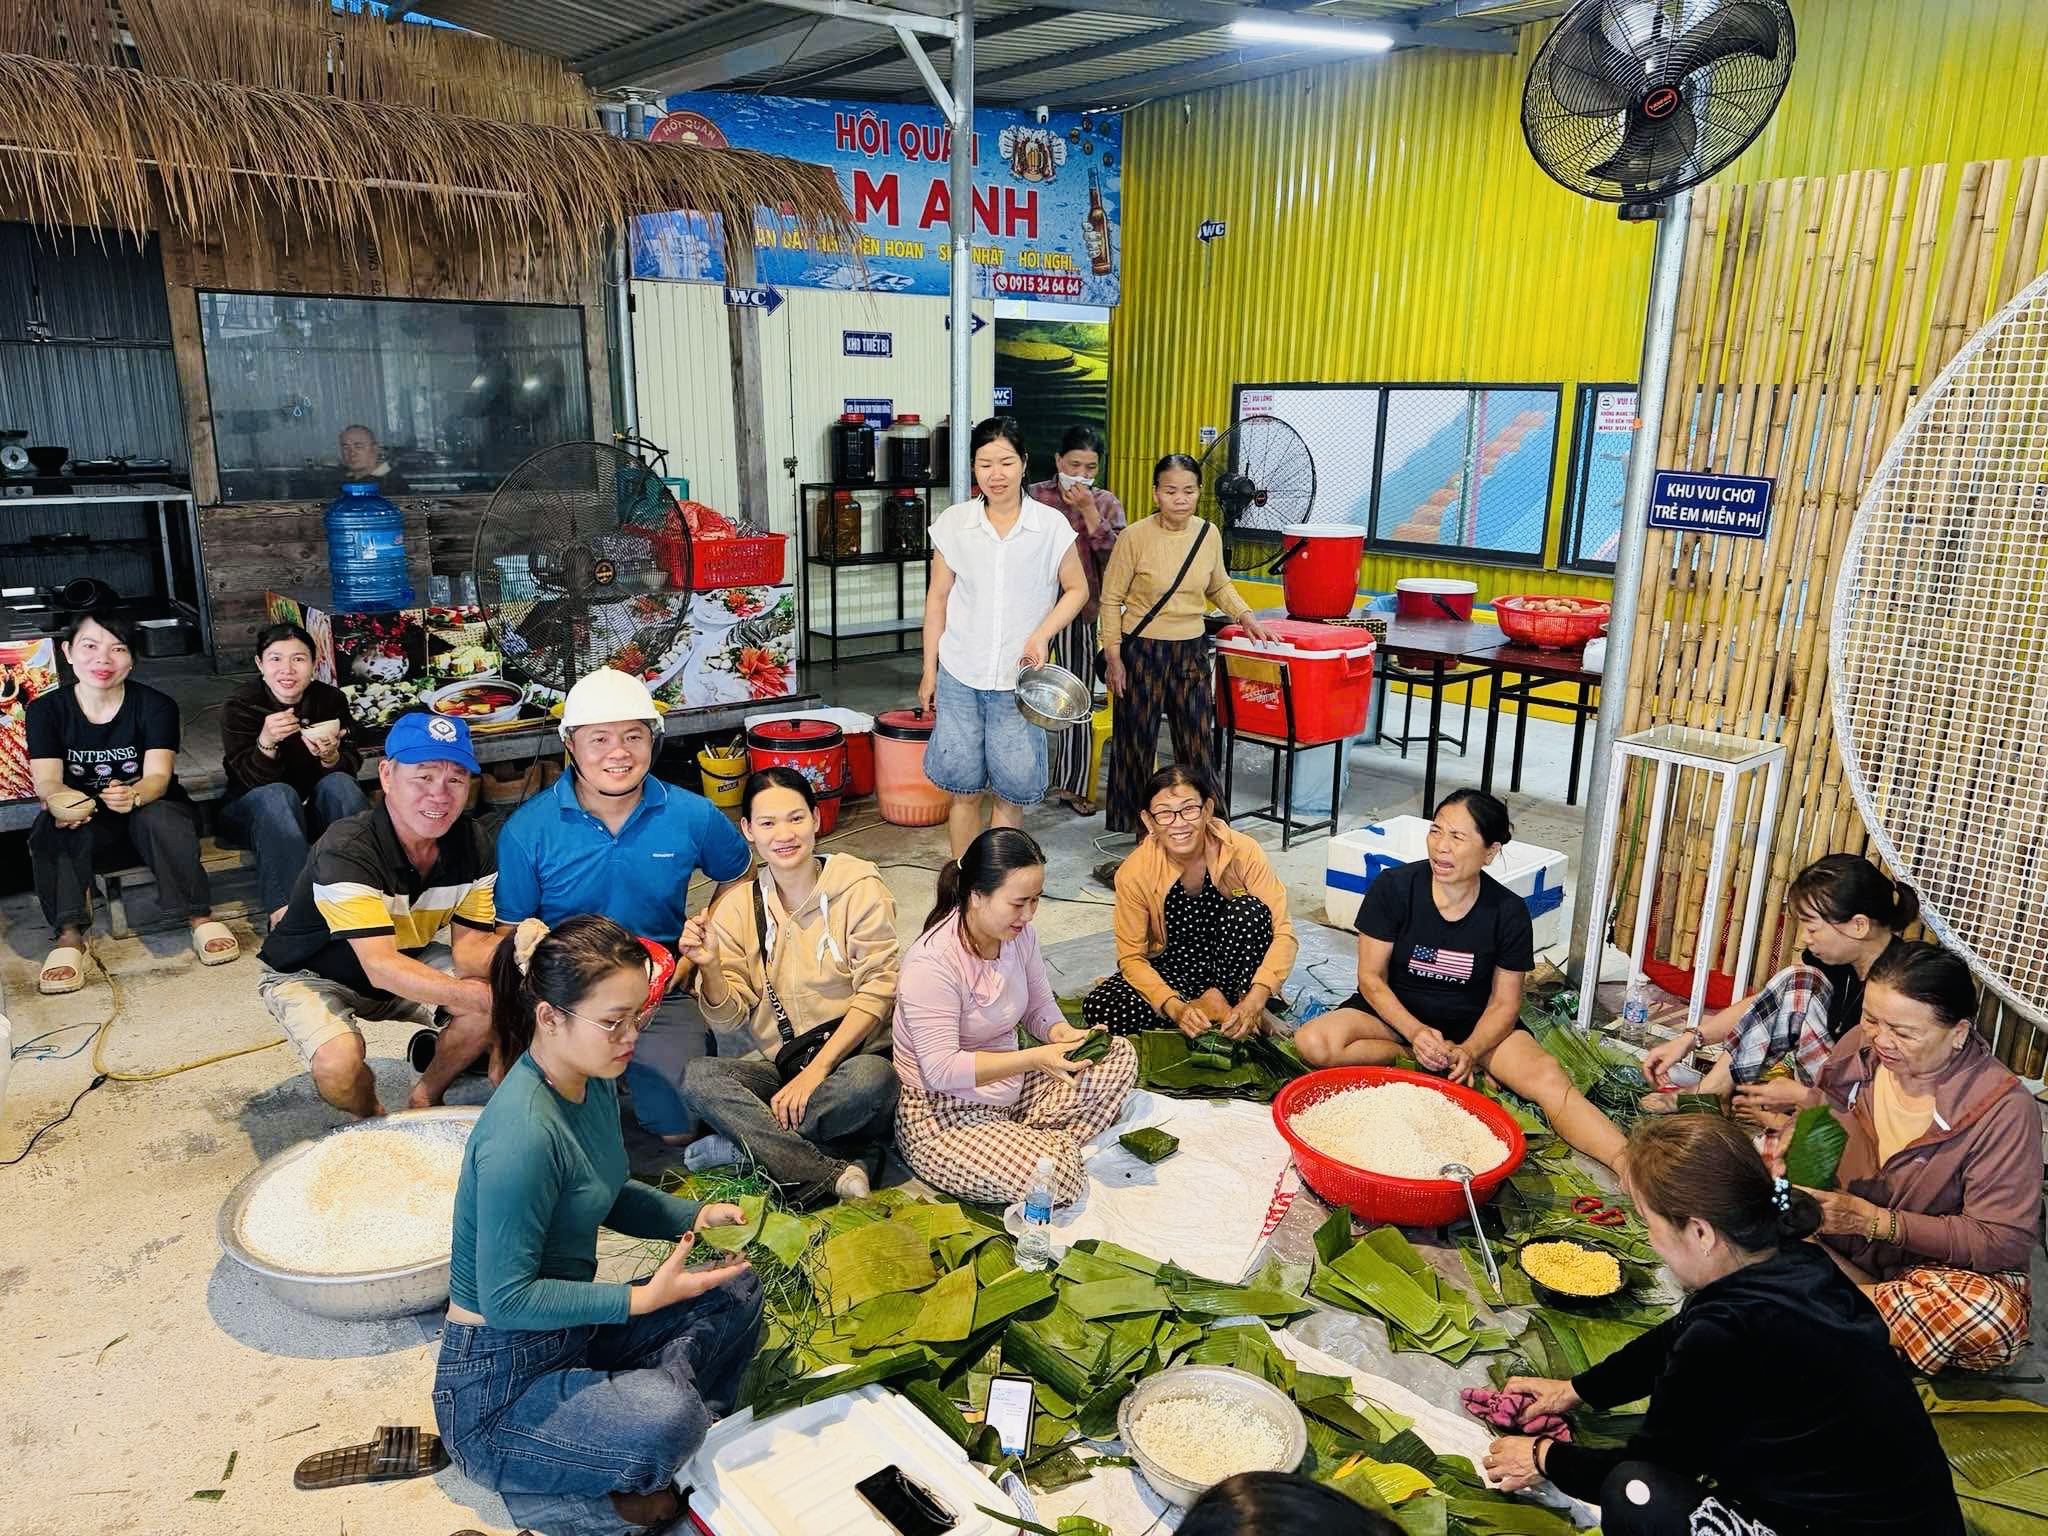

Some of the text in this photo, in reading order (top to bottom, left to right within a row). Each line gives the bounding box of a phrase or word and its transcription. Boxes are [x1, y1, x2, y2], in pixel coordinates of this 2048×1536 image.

[835, 109, 890, 158] HỘI
[919, 178, 1039, 239] ANH
[1202, 223, 1225, 237] WC
[884, 239, 924, 259] HOAN
[1009, 276, 1080, 294] 0915 34 64 64
[729, 289, 767, 306] WC
[846, 337, 861, 351] KHO
[993, 390, 1010, 400] WC
[1666, 483, 1757, 504] KHU VUI CHƠI
[1655, 502, 1762, 528] TRẺ EM MIỄN PHÍ
[67, 746, 138, 763] INTENSE
